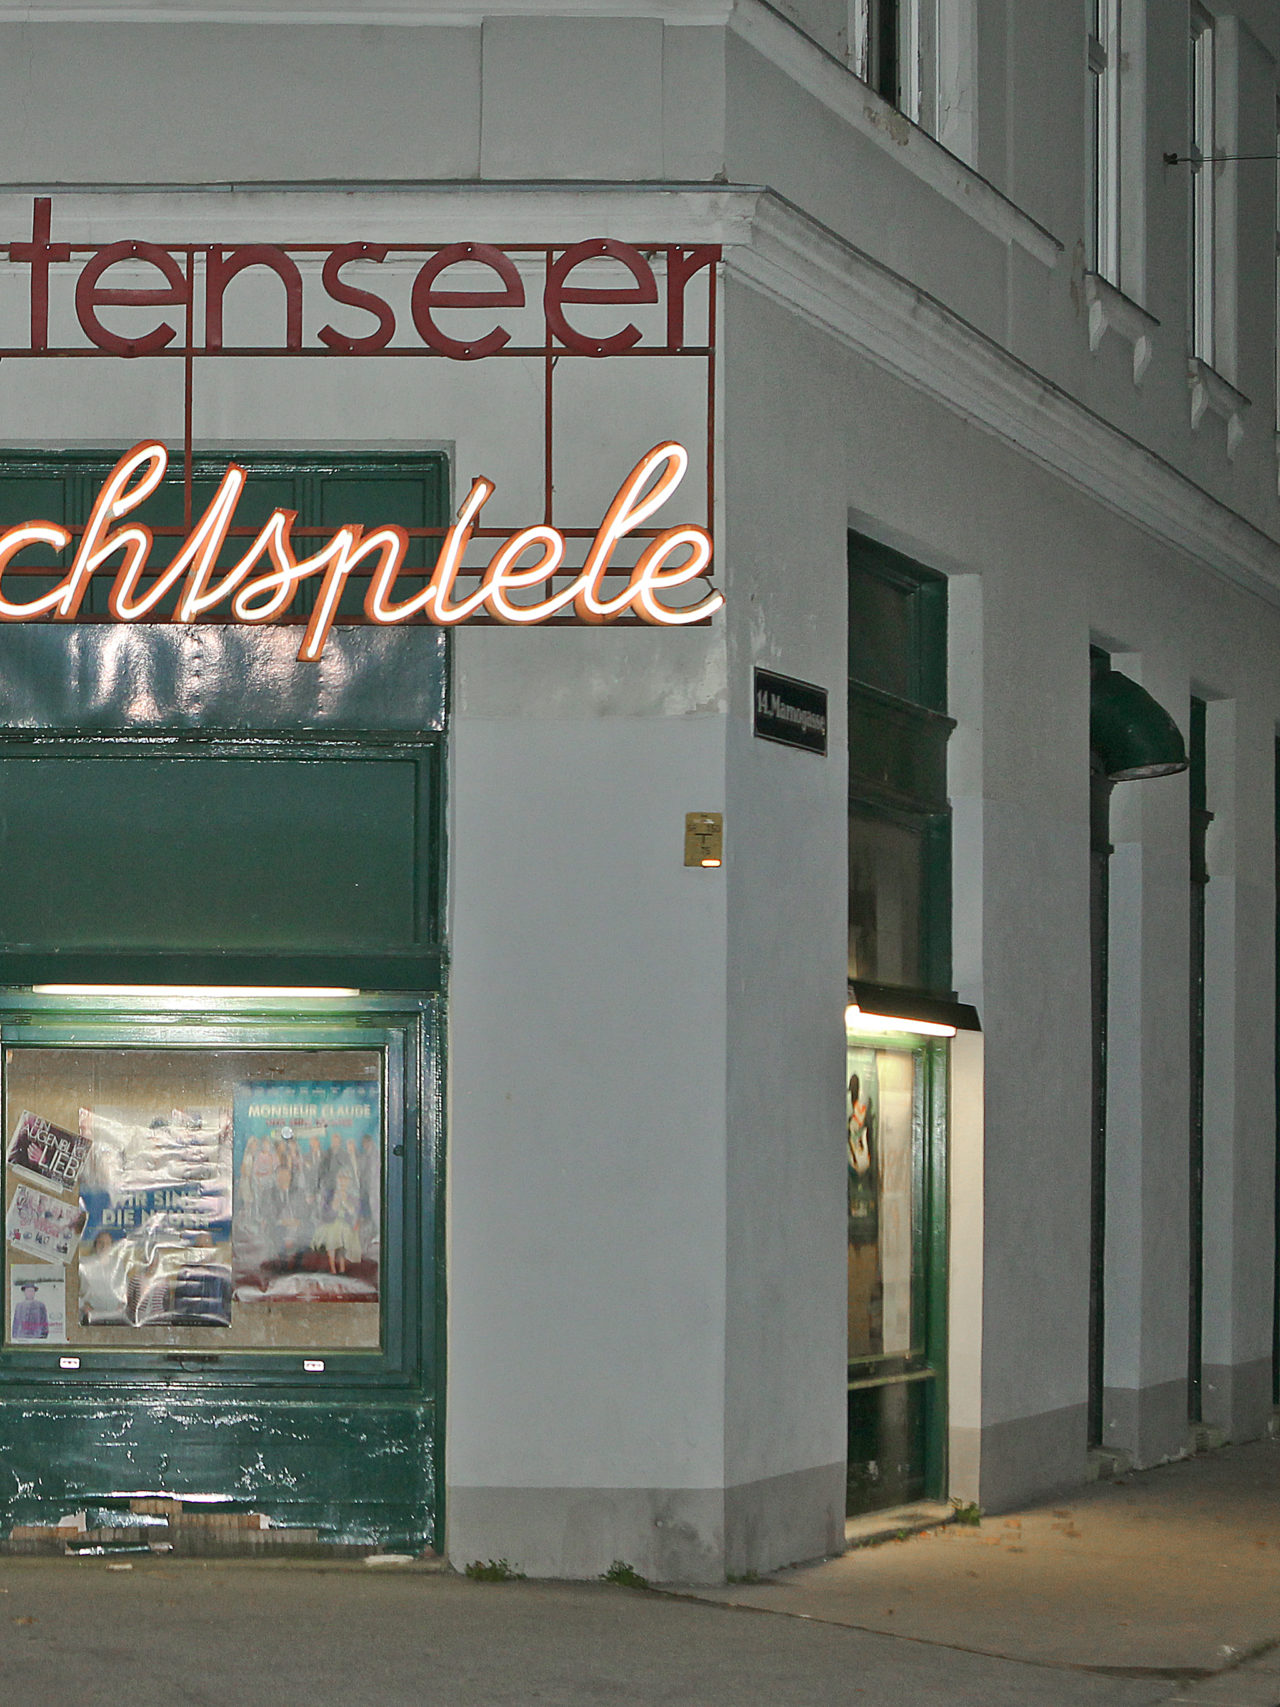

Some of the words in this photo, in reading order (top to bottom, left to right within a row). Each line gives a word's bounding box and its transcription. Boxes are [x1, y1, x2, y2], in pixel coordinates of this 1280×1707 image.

[248, 1104, 317, 1118] MONSIEUR
[321, 1104, 371, 1118] CLAUDE
[102, 1209, 135, 1226] DIE
[141, 1209, 209, 1229] NUEN
